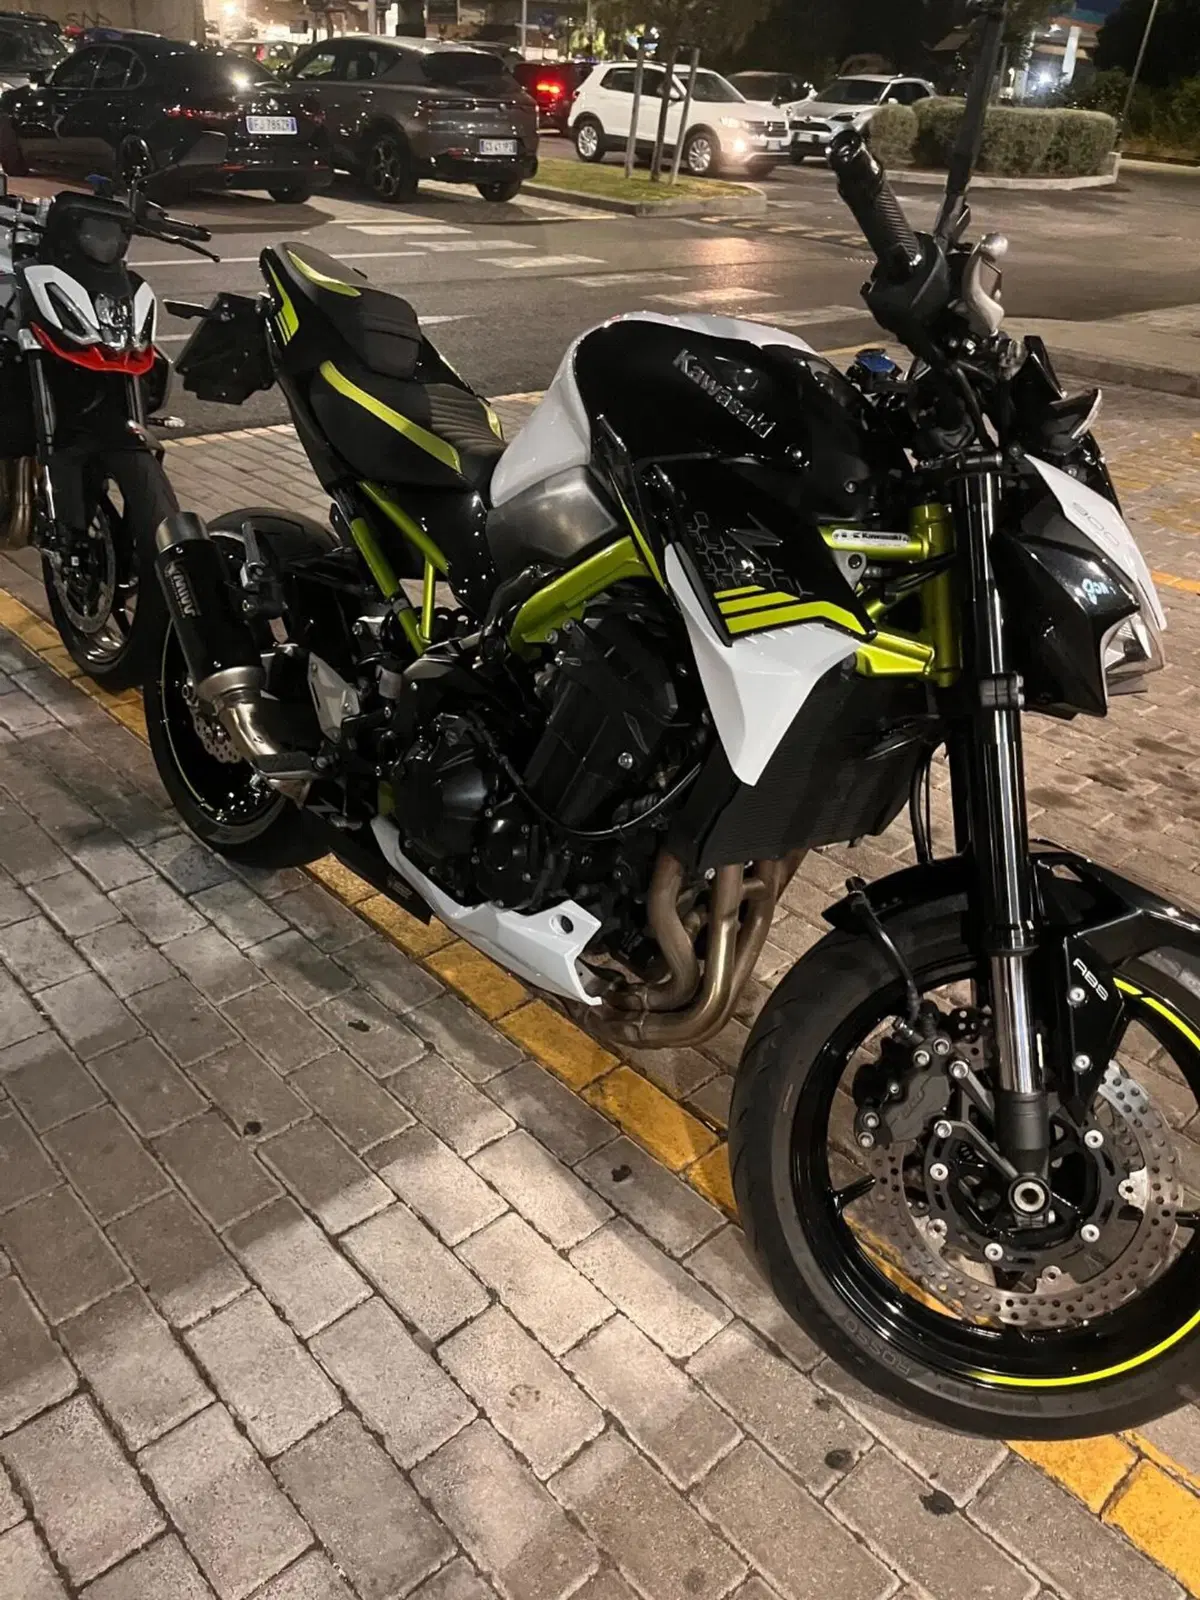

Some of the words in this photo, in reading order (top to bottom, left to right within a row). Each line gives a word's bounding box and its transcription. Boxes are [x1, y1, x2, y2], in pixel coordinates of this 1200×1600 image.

[672, 348, 776, 438] Kawasaki
[1073, 957, 1109, 1001] ABS
[843, 1318, 912, 1377] ROSSO
